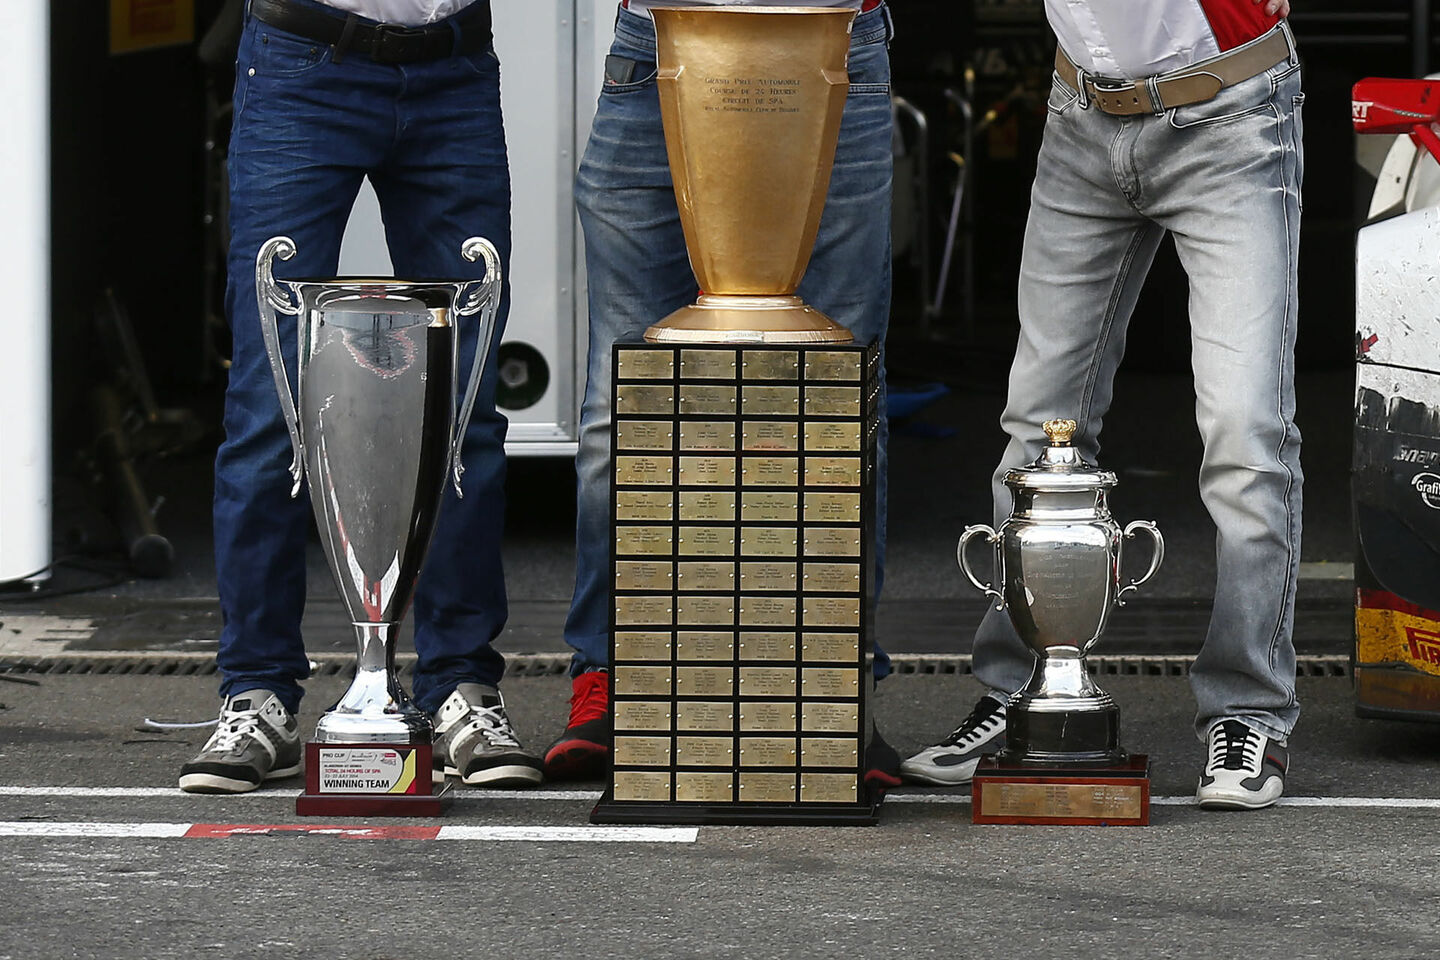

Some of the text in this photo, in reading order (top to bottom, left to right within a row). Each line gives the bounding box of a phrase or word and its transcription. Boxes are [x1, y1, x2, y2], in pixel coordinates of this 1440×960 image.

[1351, 100, 1375, 118] RT
[324, 779, 389, 788] WINNING TEAM
